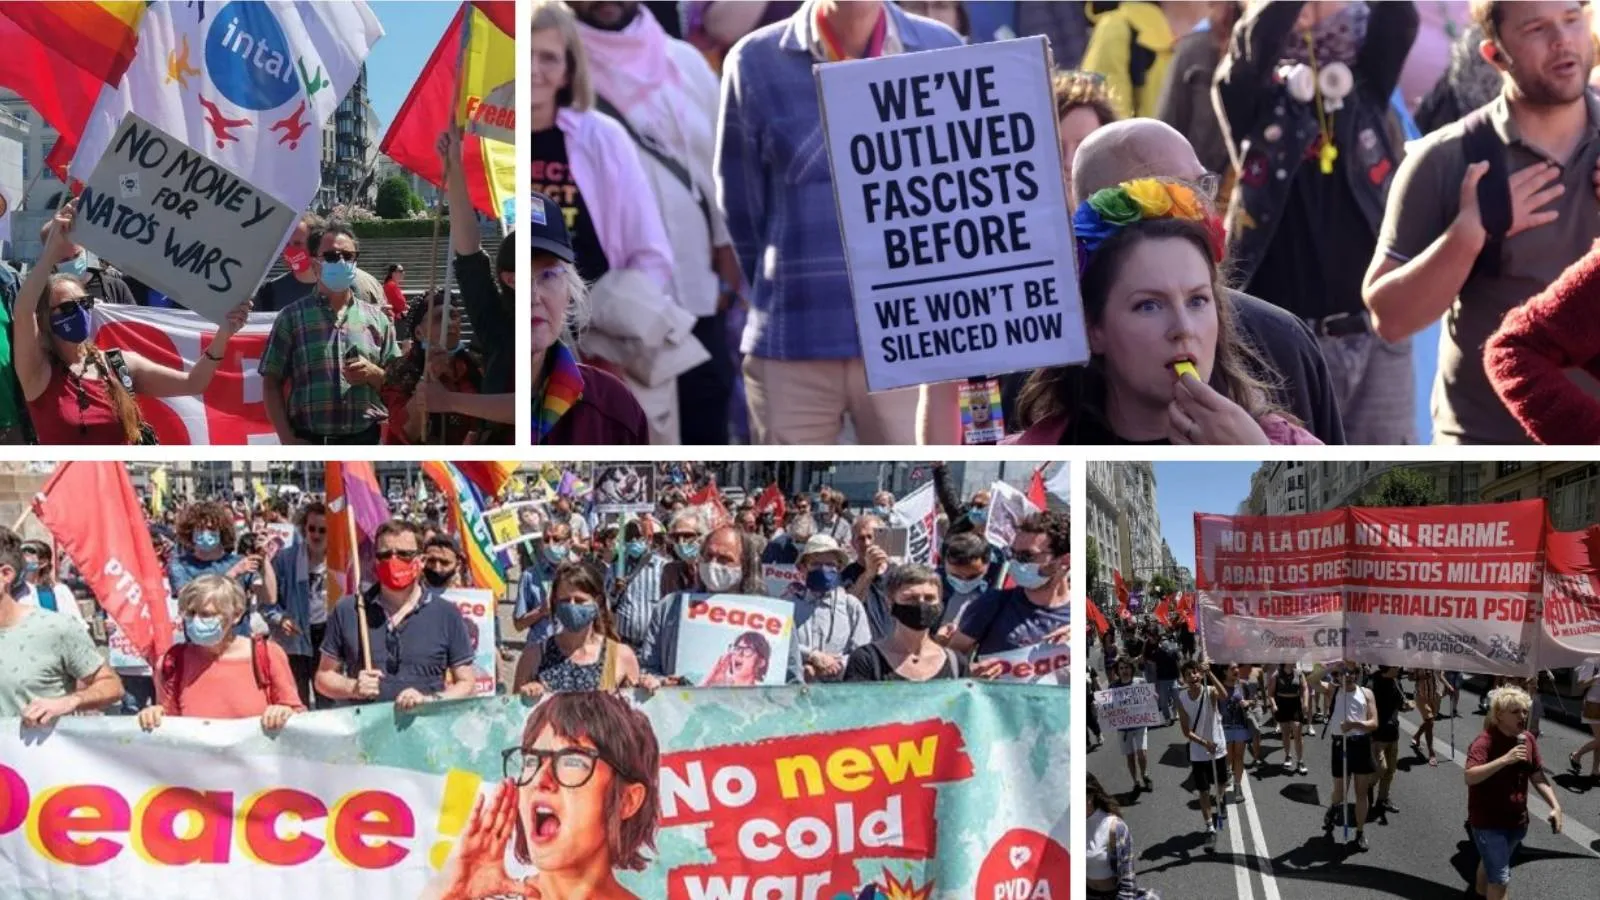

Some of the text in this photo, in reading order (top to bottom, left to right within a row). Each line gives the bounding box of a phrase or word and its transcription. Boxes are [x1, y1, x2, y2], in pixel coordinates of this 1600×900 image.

[221, 17, 293, 83] intal
[868, 65, 1000, 123] WE'VE
[850, 112, 1035, 176] OUTLIVED
[115, 122, 275, 229] NO MONEY
[862, 160, 1039, 224] FASCISTS
[152, 187, 198, 220] FOR
[77, 187, 242, 293] NATO'S WARS
[884, 211, 1031, 270] BEFORE
[874, 277, 1058, 330] WE WON'T BE
[881, 312, 1063, 363] SILENCED NOW
[1219, 529, 1247, 553] NO
[1252, 531, 1265, 553] A
[1269, 529, 1293, 553] LA
[1355, 522, 1382, 547] NO
[1387, 523, 1412, 548] AL
[1417, 521, 1515, 548] REARME.
[765, 567, 805, 581] Peac
[1222, 565, 1275, 585] ABAJO
[1279, 563, 1309, 585] LOS
[1312, 558, 1443, 583] PRESUPUESTOS
[1350, 591, 1478, 620] IMPERIALISTA
[1313, 627, 1349, 648] CRT
[660, 734, 939, 818] No new
[738, 796, 904, 862] cold
[994, 877, 1053, 900] PVDA
